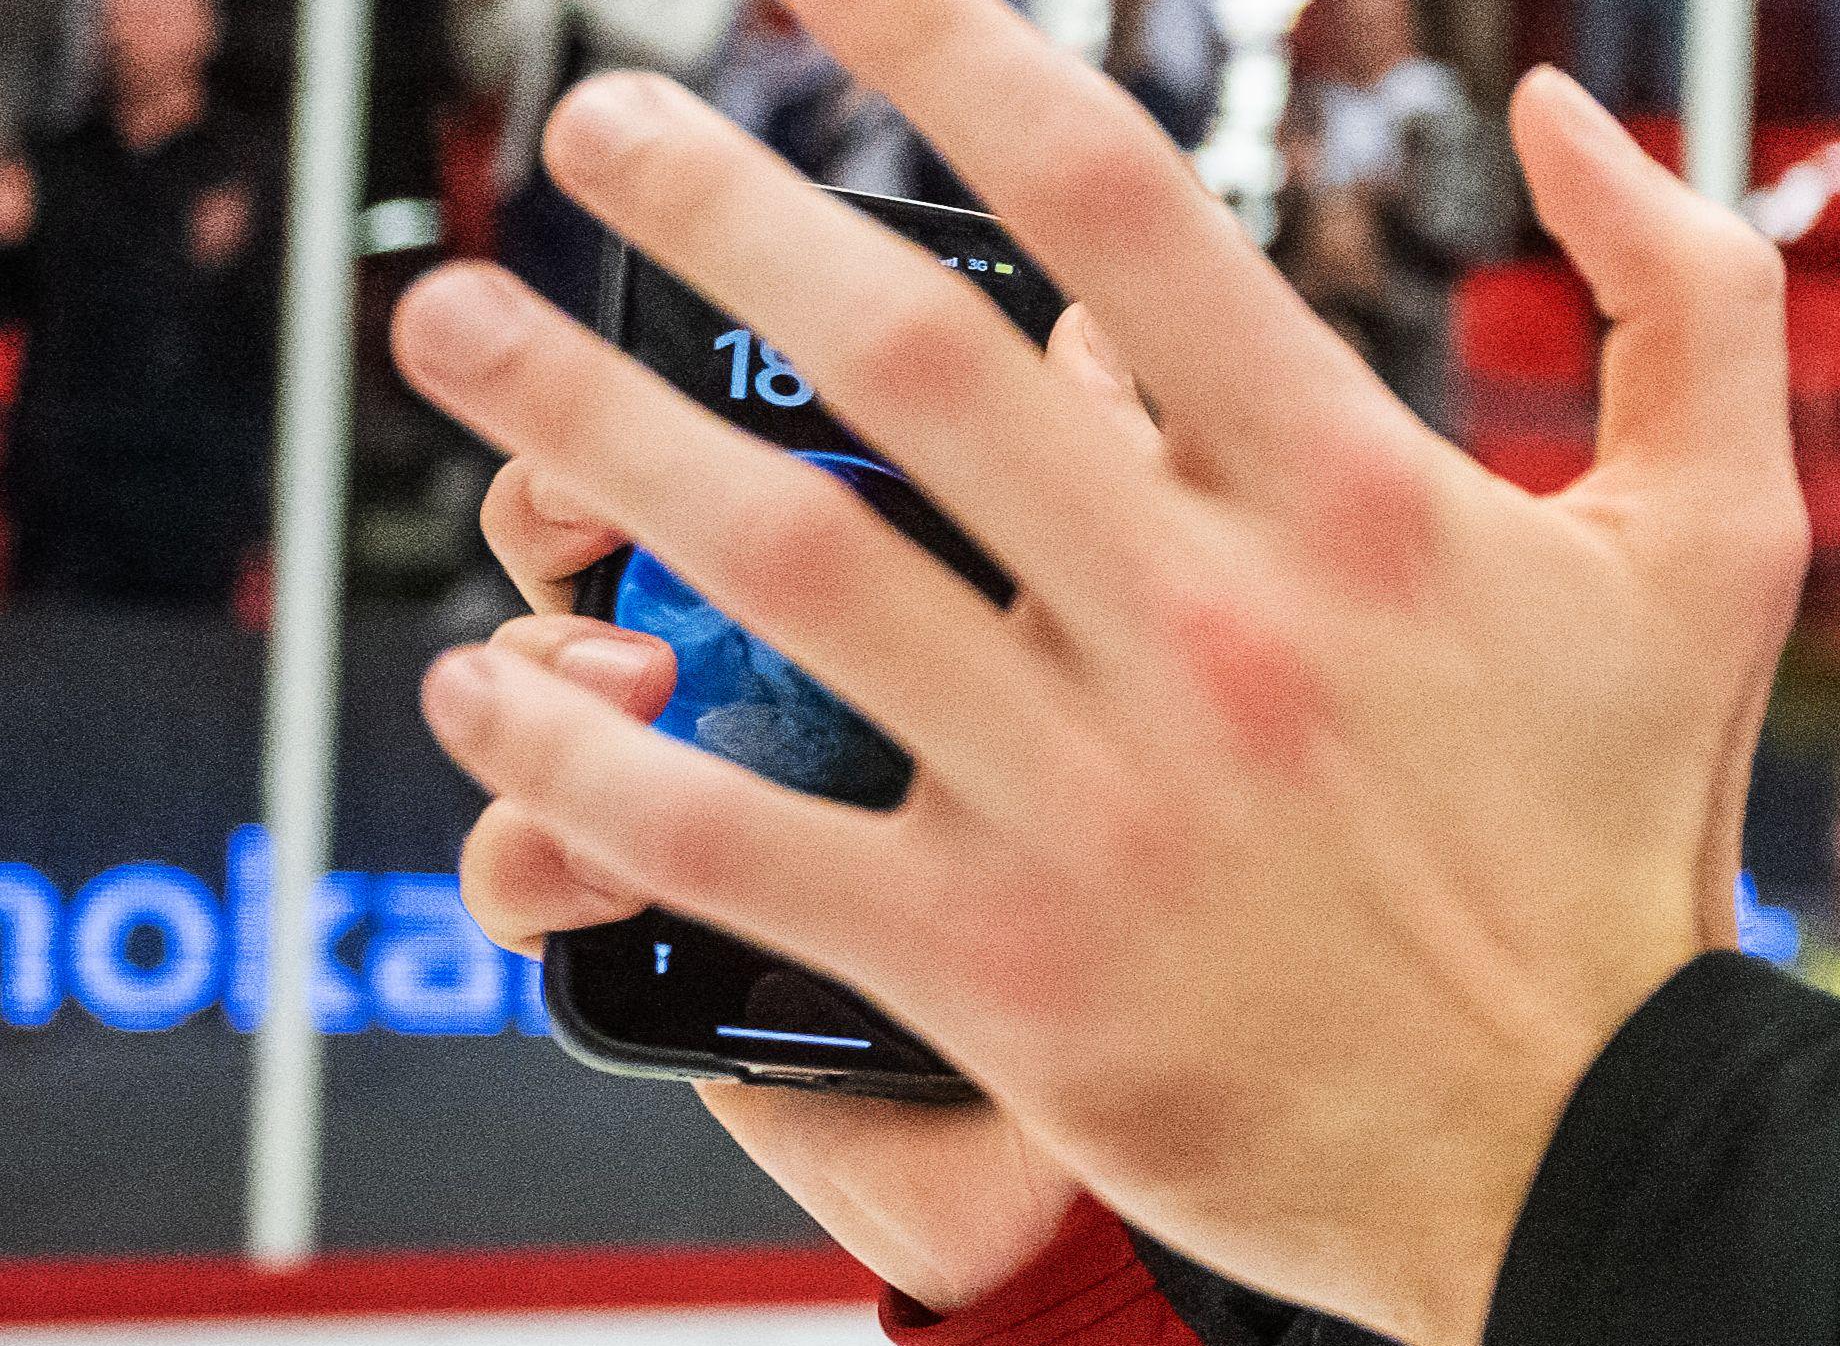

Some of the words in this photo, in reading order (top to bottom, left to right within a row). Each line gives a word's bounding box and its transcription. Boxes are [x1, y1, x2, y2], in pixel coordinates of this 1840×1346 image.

[967, 257, 988, 272] 3G
[714, 328, 815, 407] 18
[0, 821, 552, 1037] oka
